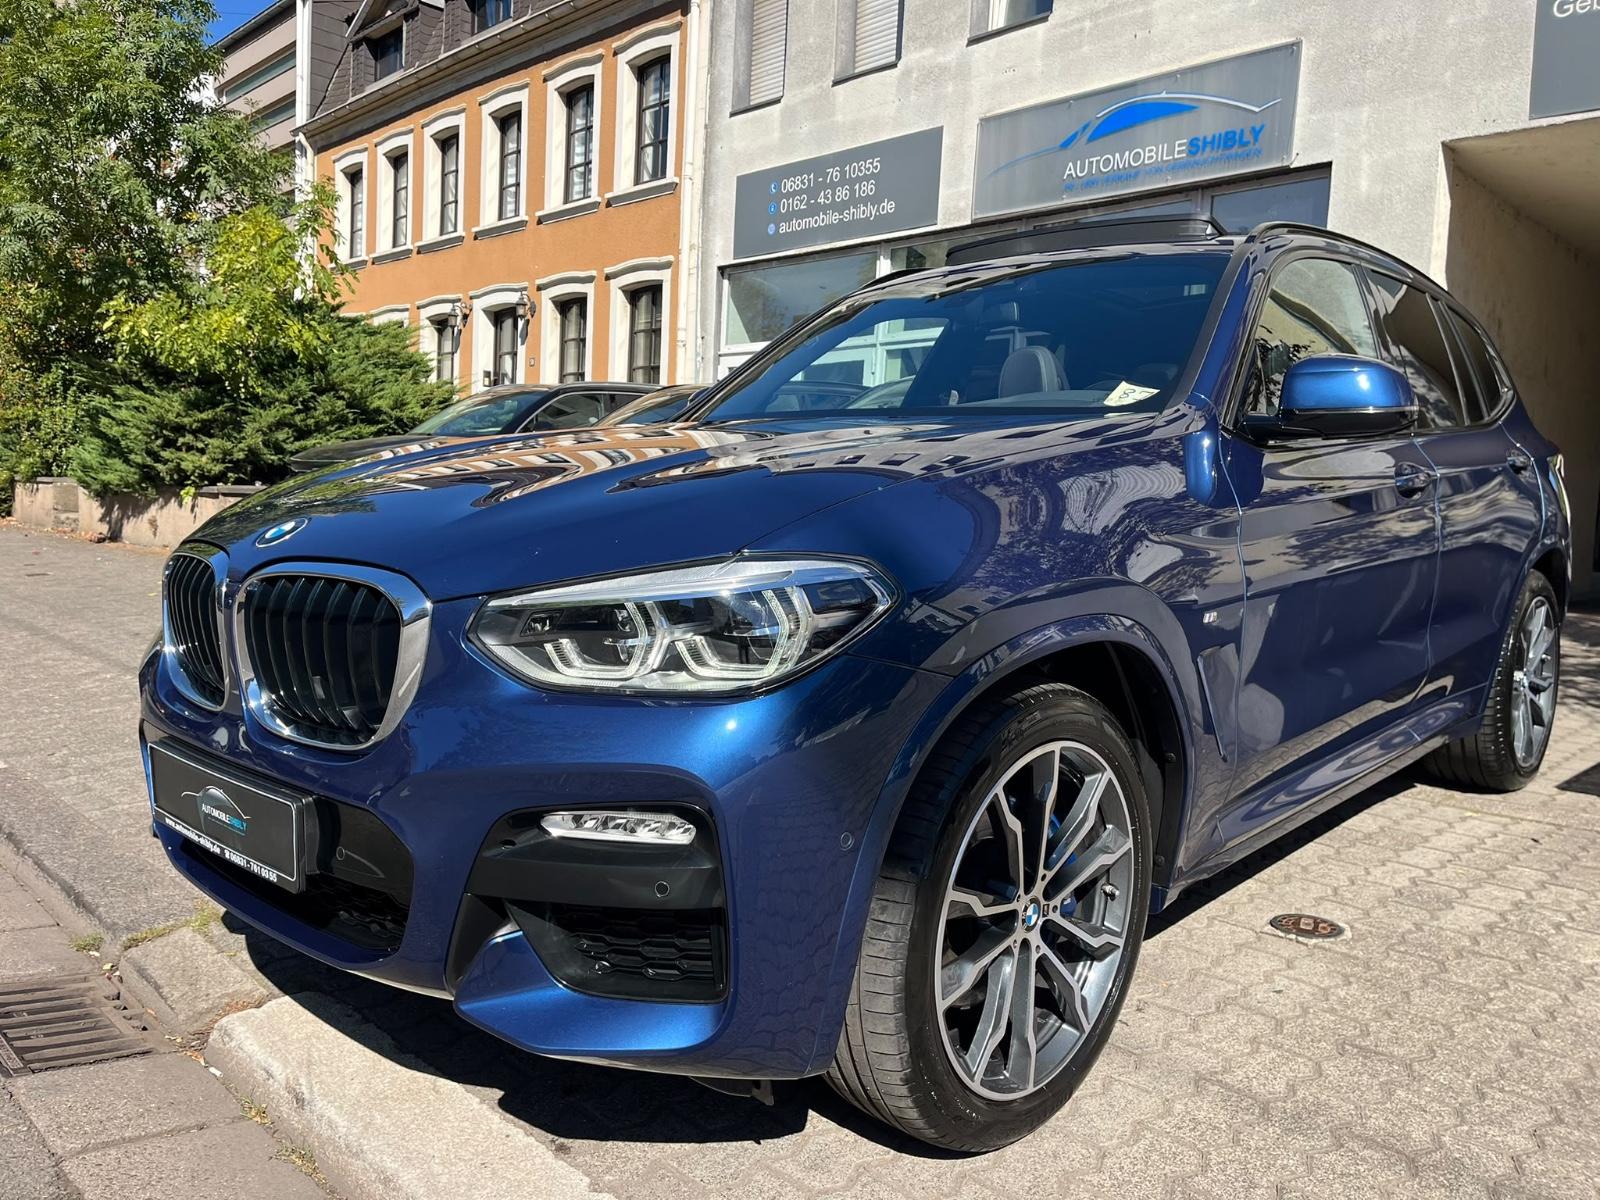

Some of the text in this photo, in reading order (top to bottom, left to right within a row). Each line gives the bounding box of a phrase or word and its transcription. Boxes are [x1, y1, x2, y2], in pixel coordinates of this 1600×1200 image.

[1063, 124, 1265, 180] AUTOMOBILESHIBLY
[781, 172, 814, 193] 06831
[826, 166, 841, 184] 76
[844, 157, 881, 179] 10355
[780, 194, 808, 213] 0162
[817, 189, 832, 205] 43
[835, 185, 850, 202] 86
[854, 179, 876, 198] 186
[779, 198, 896, 234] automobile-shibly.de
